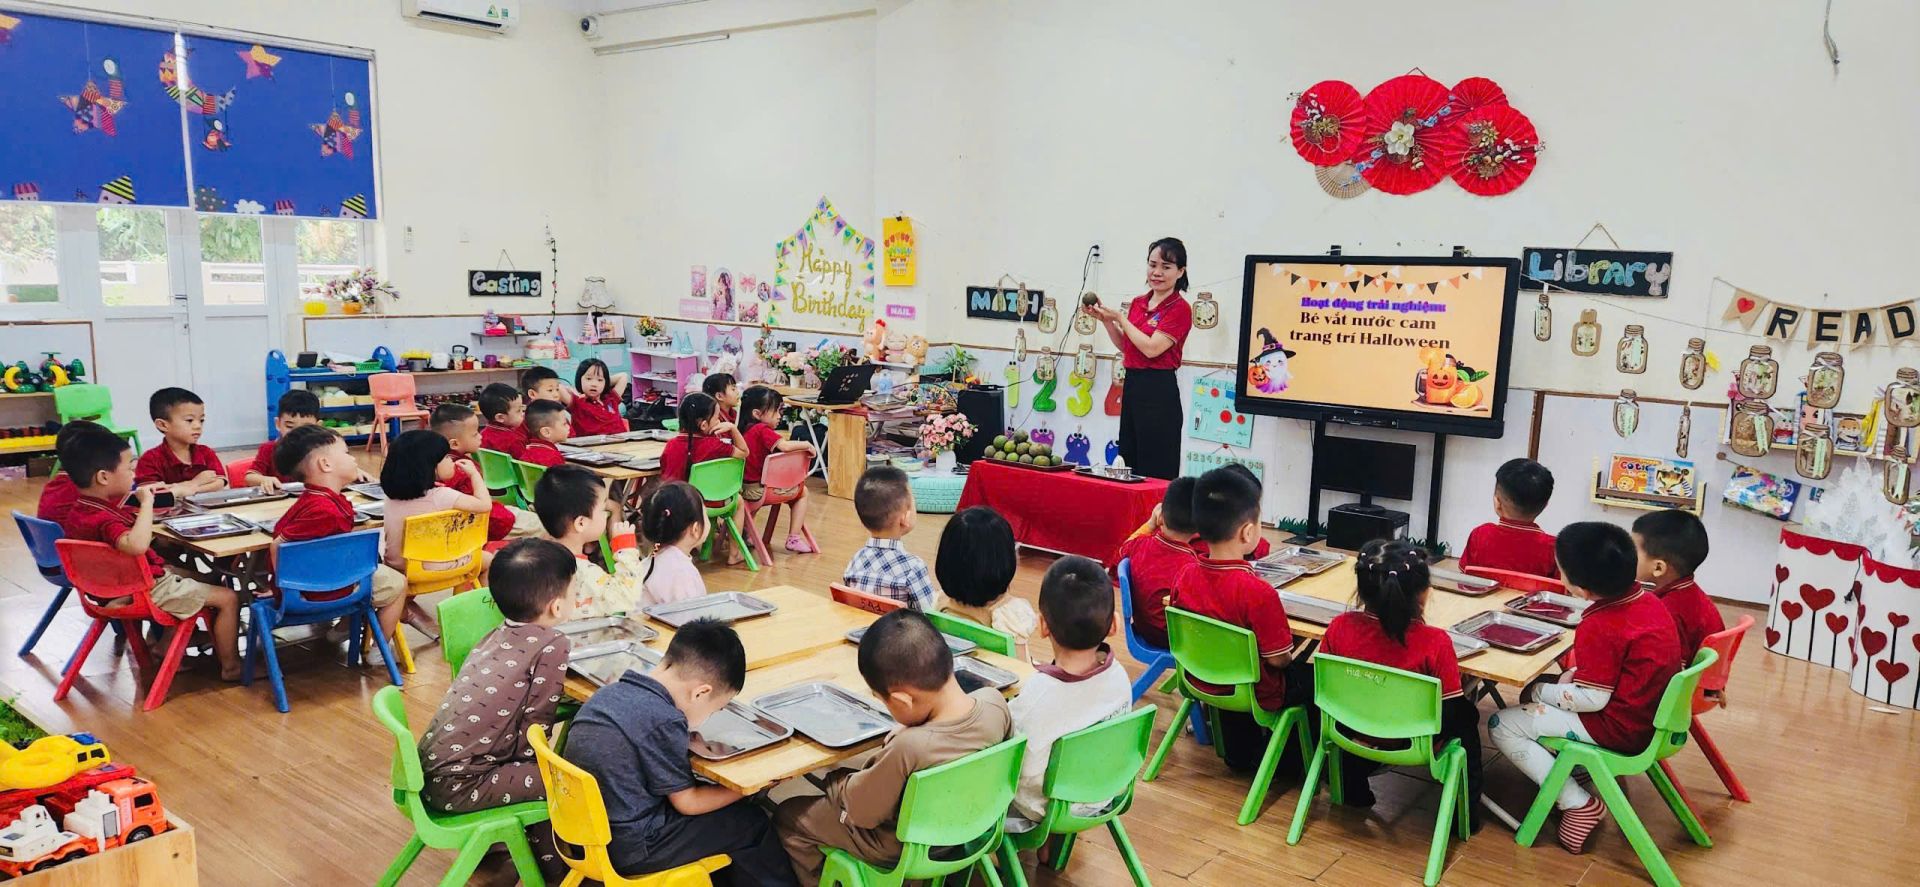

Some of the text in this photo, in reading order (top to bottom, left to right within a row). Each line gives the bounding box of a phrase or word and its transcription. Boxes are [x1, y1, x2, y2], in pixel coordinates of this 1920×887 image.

[799, 242, 852, 290] Happy
[472, 271, 541, 296] Casting
[791, 281, 865, 333] Birthday
[1301, 297, 1329, 309] Hoạt
[1332, 298, 1364, 311] động
[1300, 311, 1320, 324] Bé
[1352, 315, 1396, 328] nước
[1400, 318, 1437, 330] cam
[1767, 306, 1915, 343] READ
[1290, 329, 1450, 349] trang trí Halloween
[1032, 366, 1057, 412] 2
[1066, 370, 1094, 417] 3
